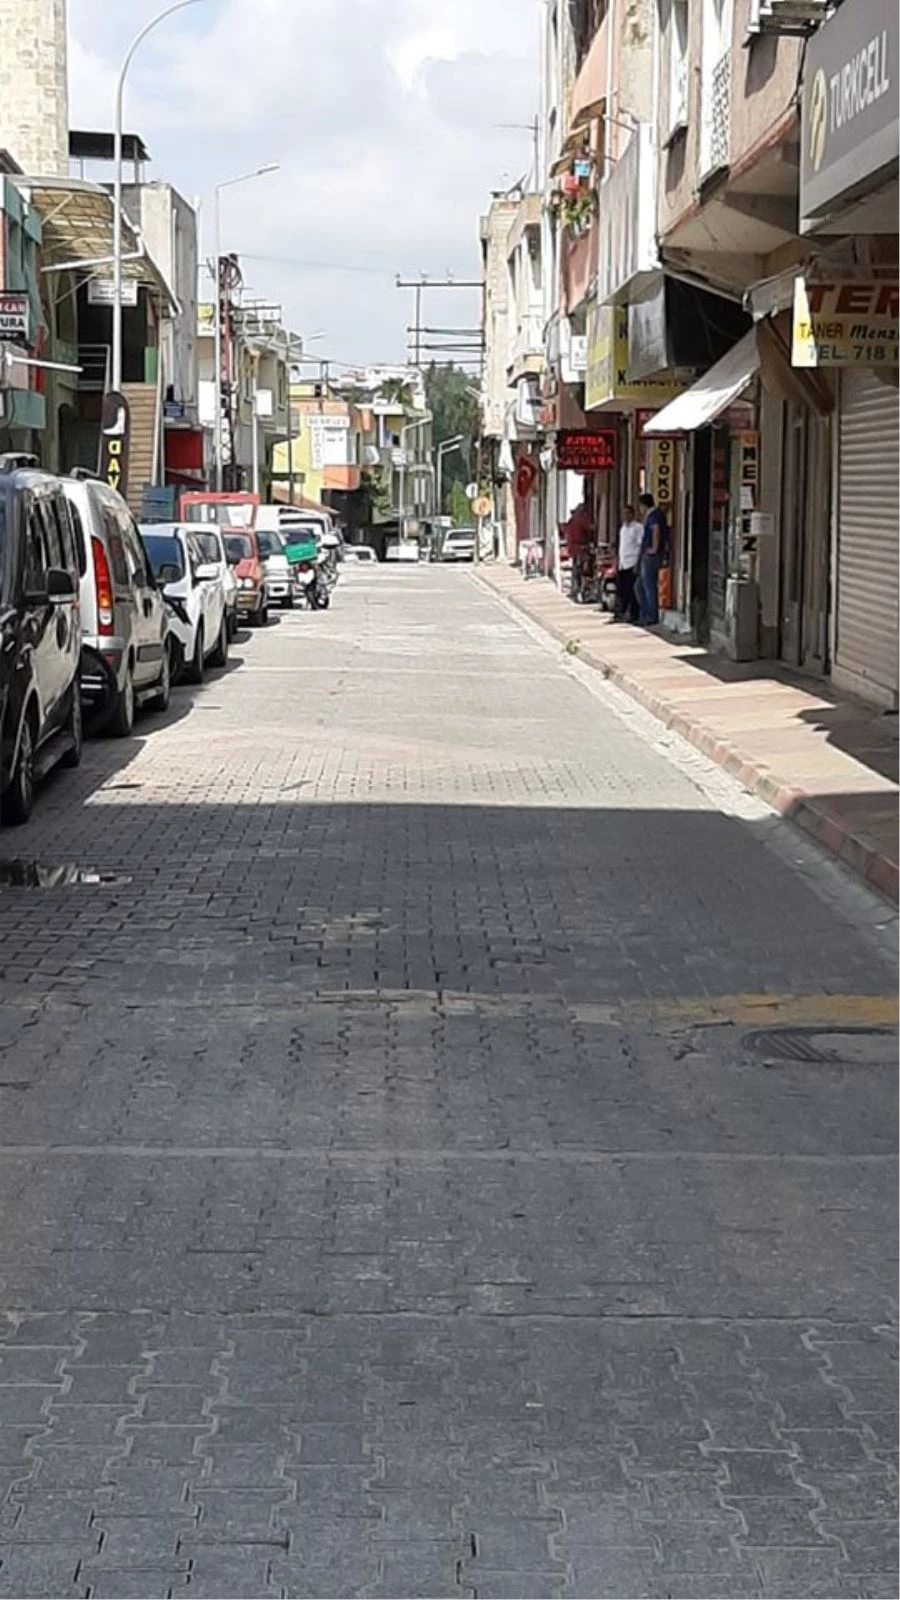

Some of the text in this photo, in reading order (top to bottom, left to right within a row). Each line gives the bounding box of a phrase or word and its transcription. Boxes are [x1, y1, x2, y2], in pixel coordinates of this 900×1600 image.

[831, 30, 889, 134] TURKCELL
[800, 323, 843, 338] TANER
[853, 345, 886, 360] 718
